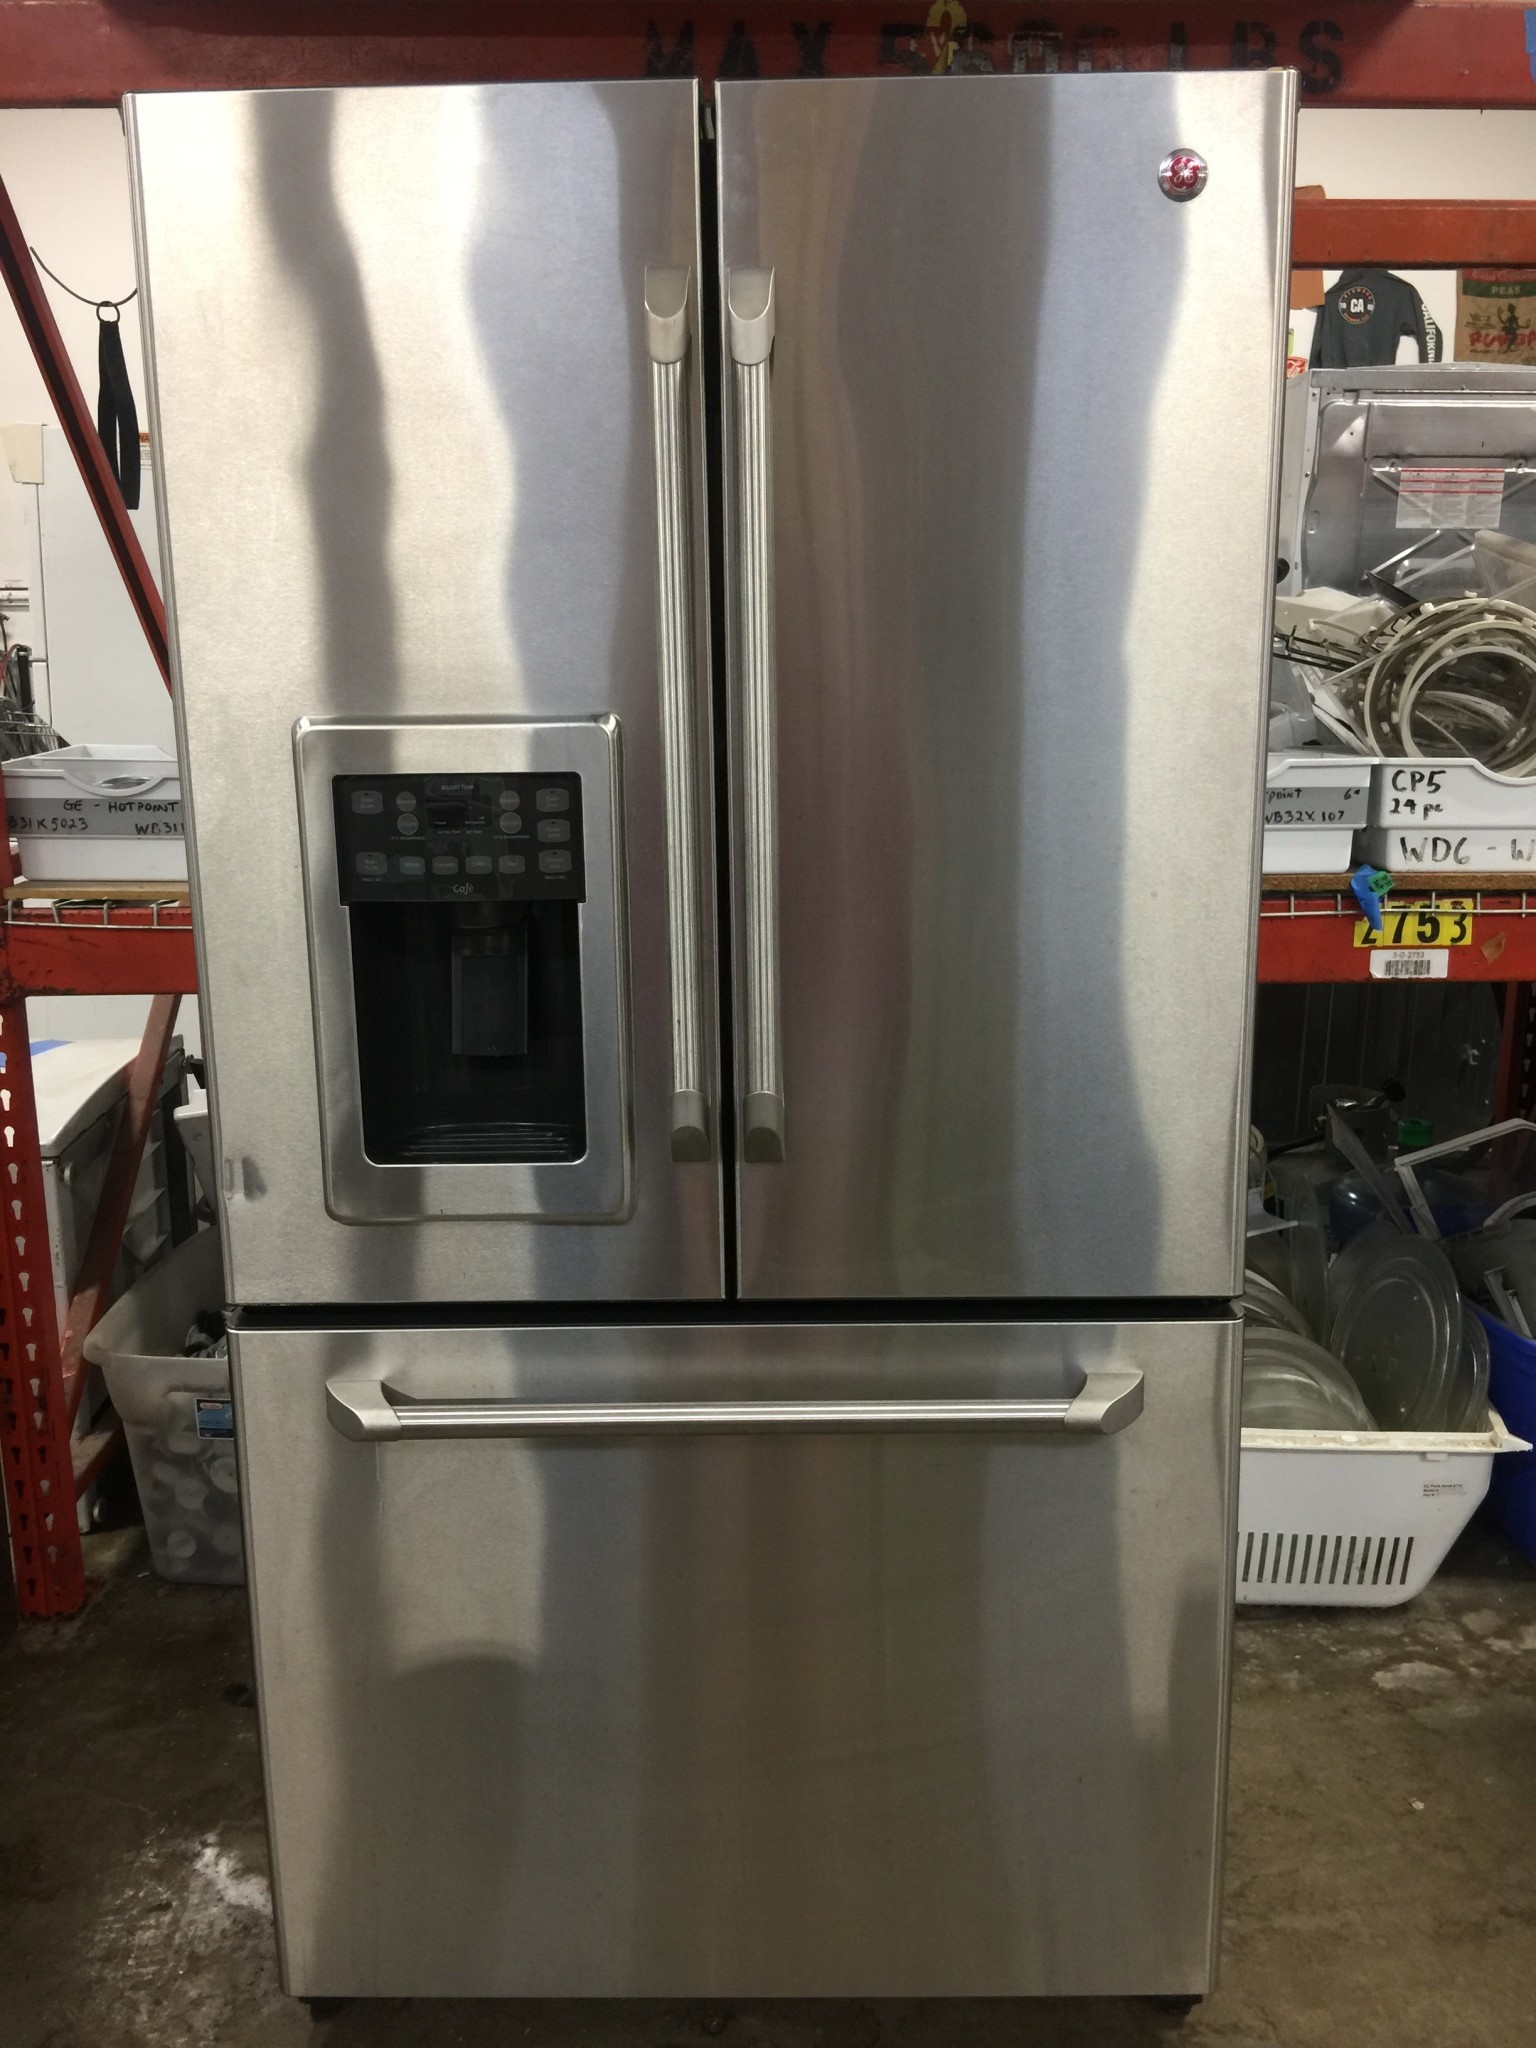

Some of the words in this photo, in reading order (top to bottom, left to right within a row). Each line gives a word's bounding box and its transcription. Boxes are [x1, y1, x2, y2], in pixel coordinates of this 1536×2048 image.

[646, 18, 832, 78] MAX
[1491, 286, 1521, 295] PEAS
[1350, 298, 1365, 313] CA
[1391, 769, 1447, 794] CP5
[63, 799, 83, 811] GE
[108, 801, 179, 814] HOTPOINT
[1389, 797, 1417, 815] 24
[1399, 836, 1471, 865] WD6
[452, 882, 475, 895] Café
